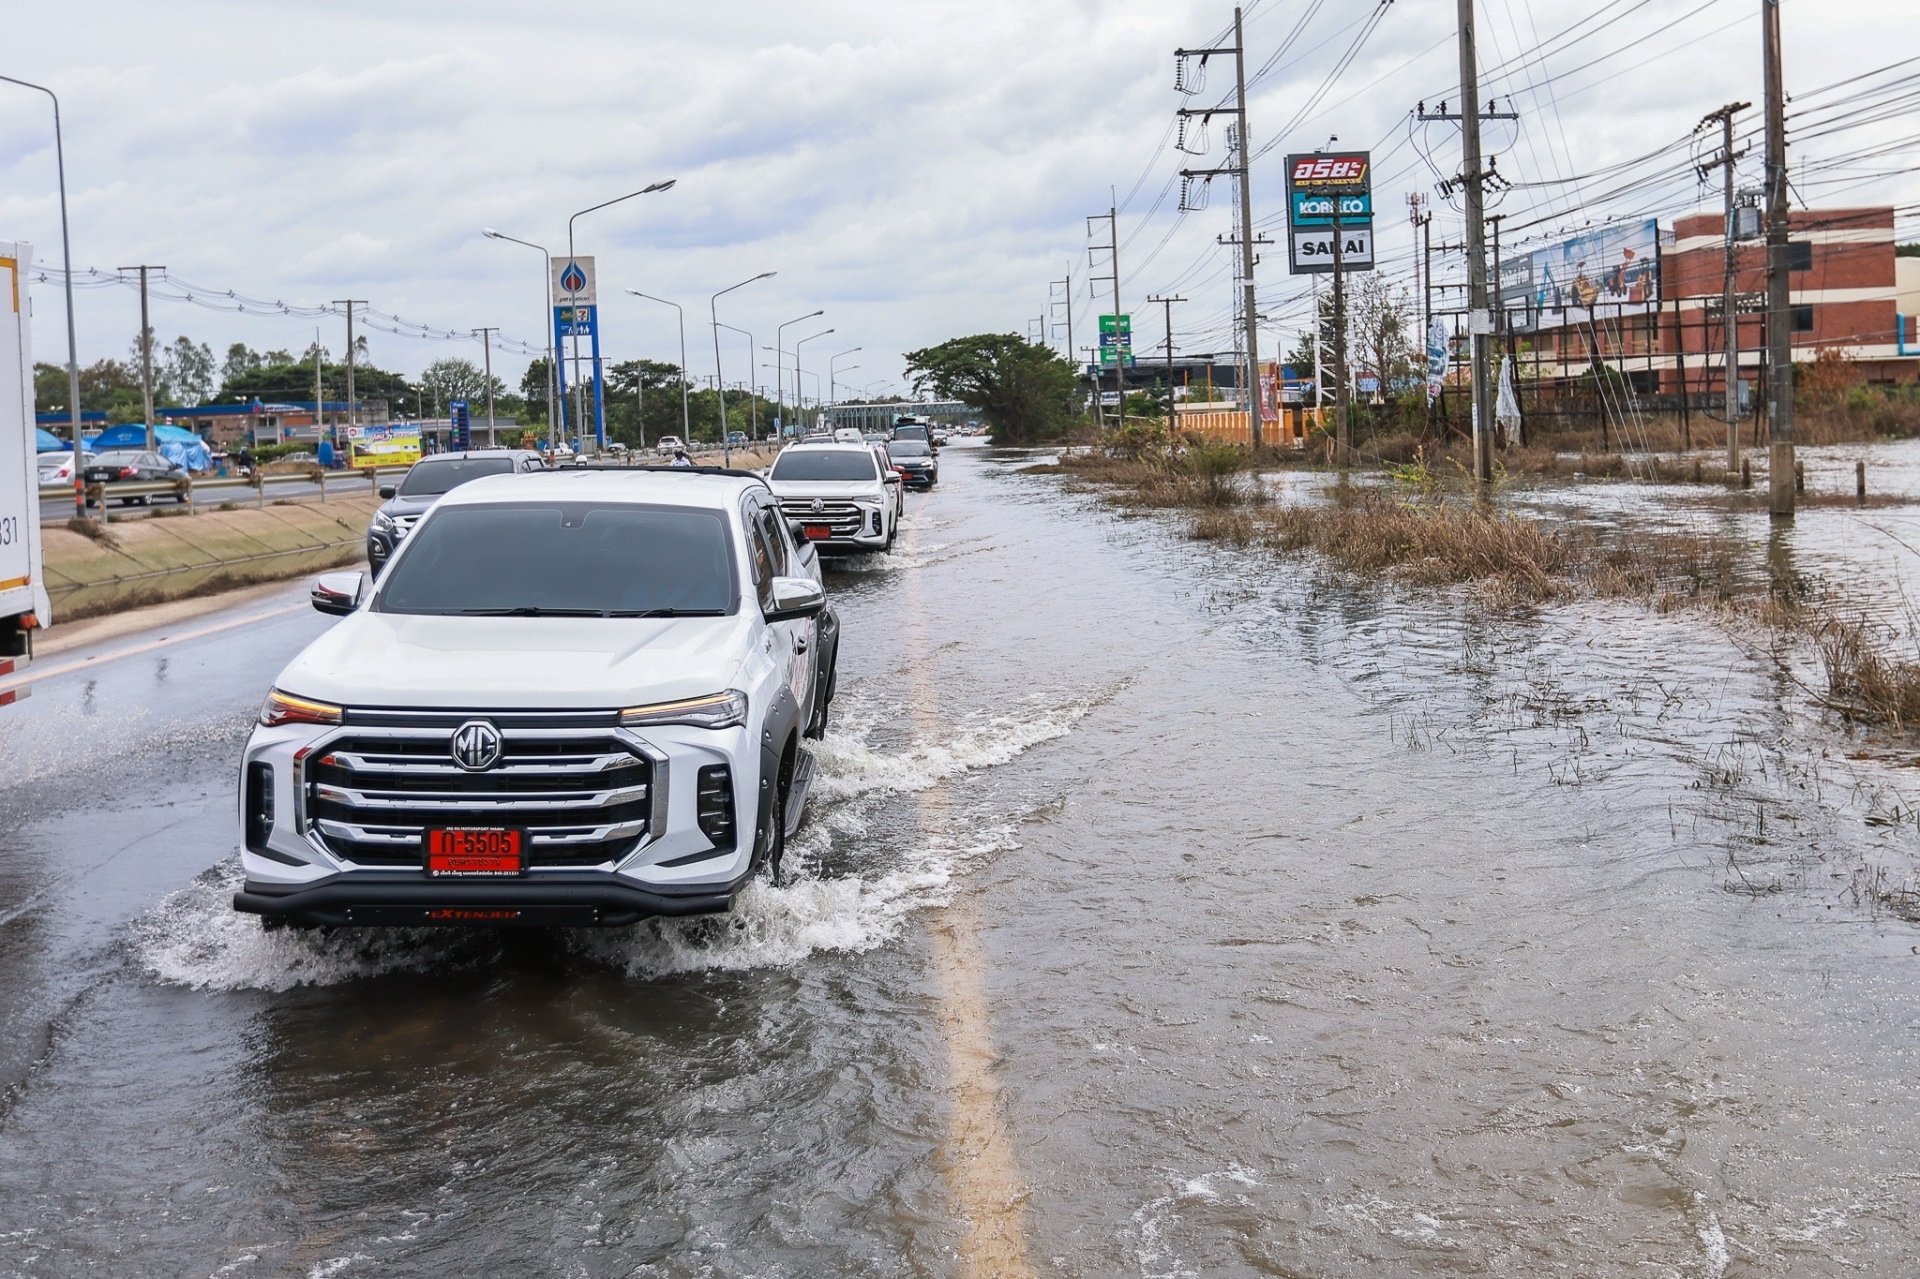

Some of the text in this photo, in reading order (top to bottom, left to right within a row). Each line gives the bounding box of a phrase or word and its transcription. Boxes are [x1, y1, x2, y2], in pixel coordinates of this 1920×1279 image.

[1294, 159, 1361, 178] อริยะ
[457, 726, 496, 766] MG
[442, 831, 512, 853] ก-5505
